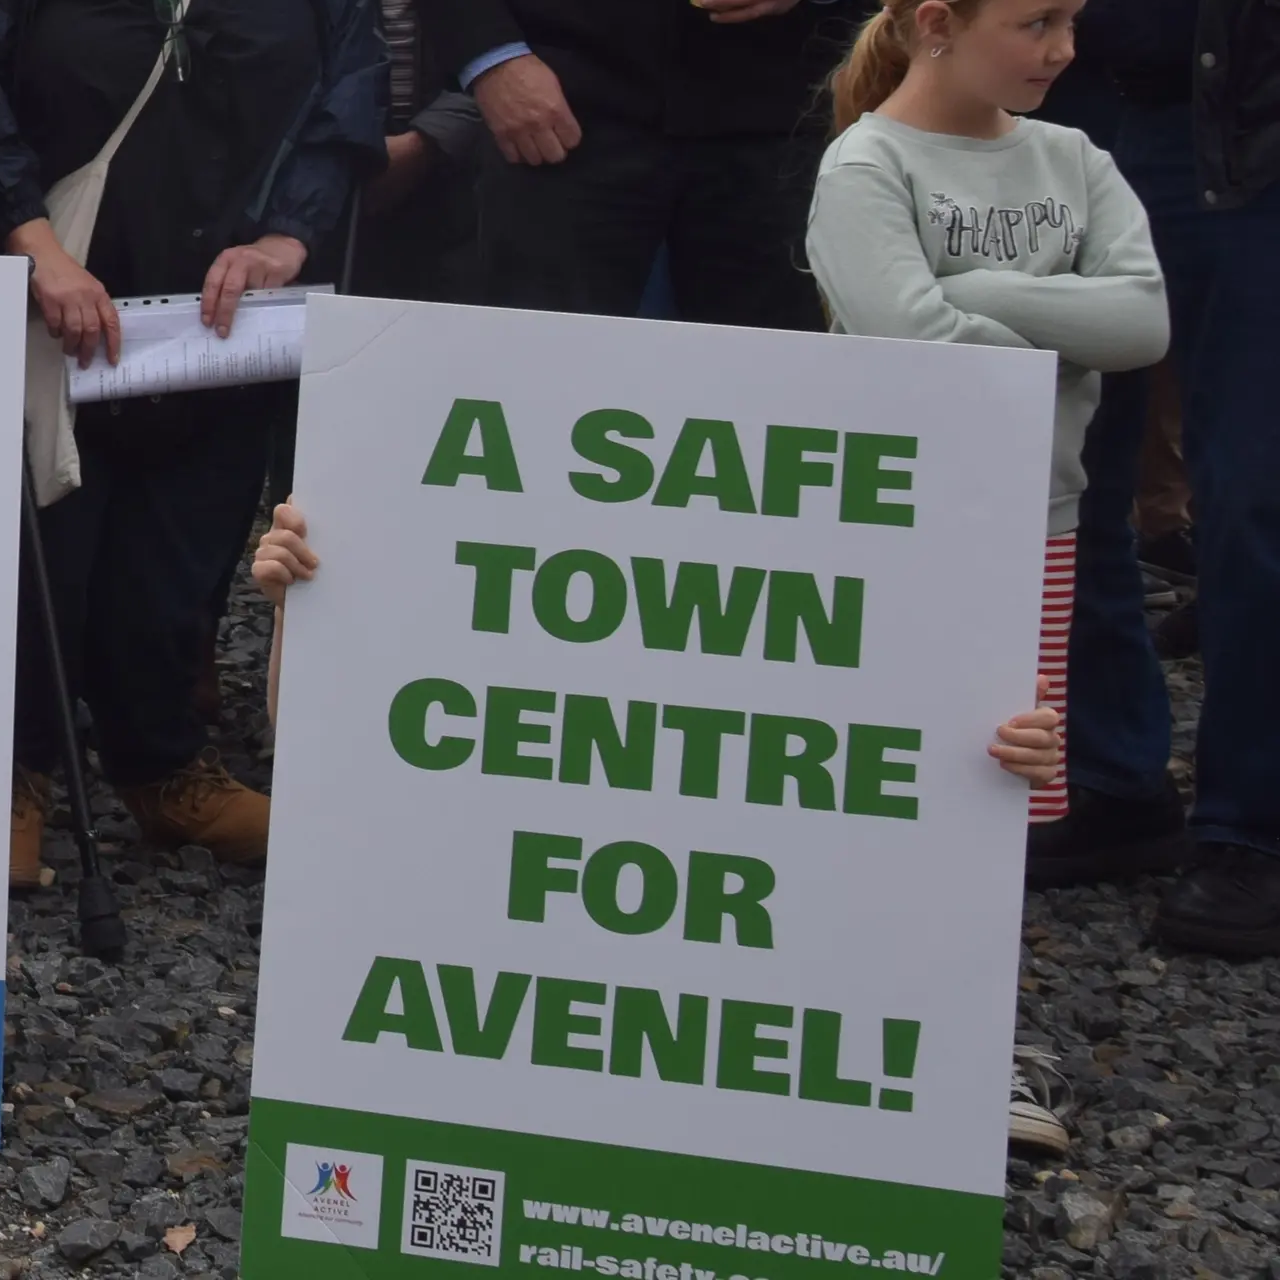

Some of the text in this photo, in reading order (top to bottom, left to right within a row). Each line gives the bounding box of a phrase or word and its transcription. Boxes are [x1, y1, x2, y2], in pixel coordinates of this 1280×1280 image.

[421, 398, 919, 528] A SAFE
[454, 541, 865, 669] TOWN
[387, 677, 922, 821] CENTRE
[506, 830, 776, 950] FOR
[341, 956, 921, 1113] AVENEL!
[313, 1196, 351, 1208] AVENEL
[313, 1206, 349, 1216] ACTIVE
[522, 1198, 945, 1276] www.avenelactive.au/
